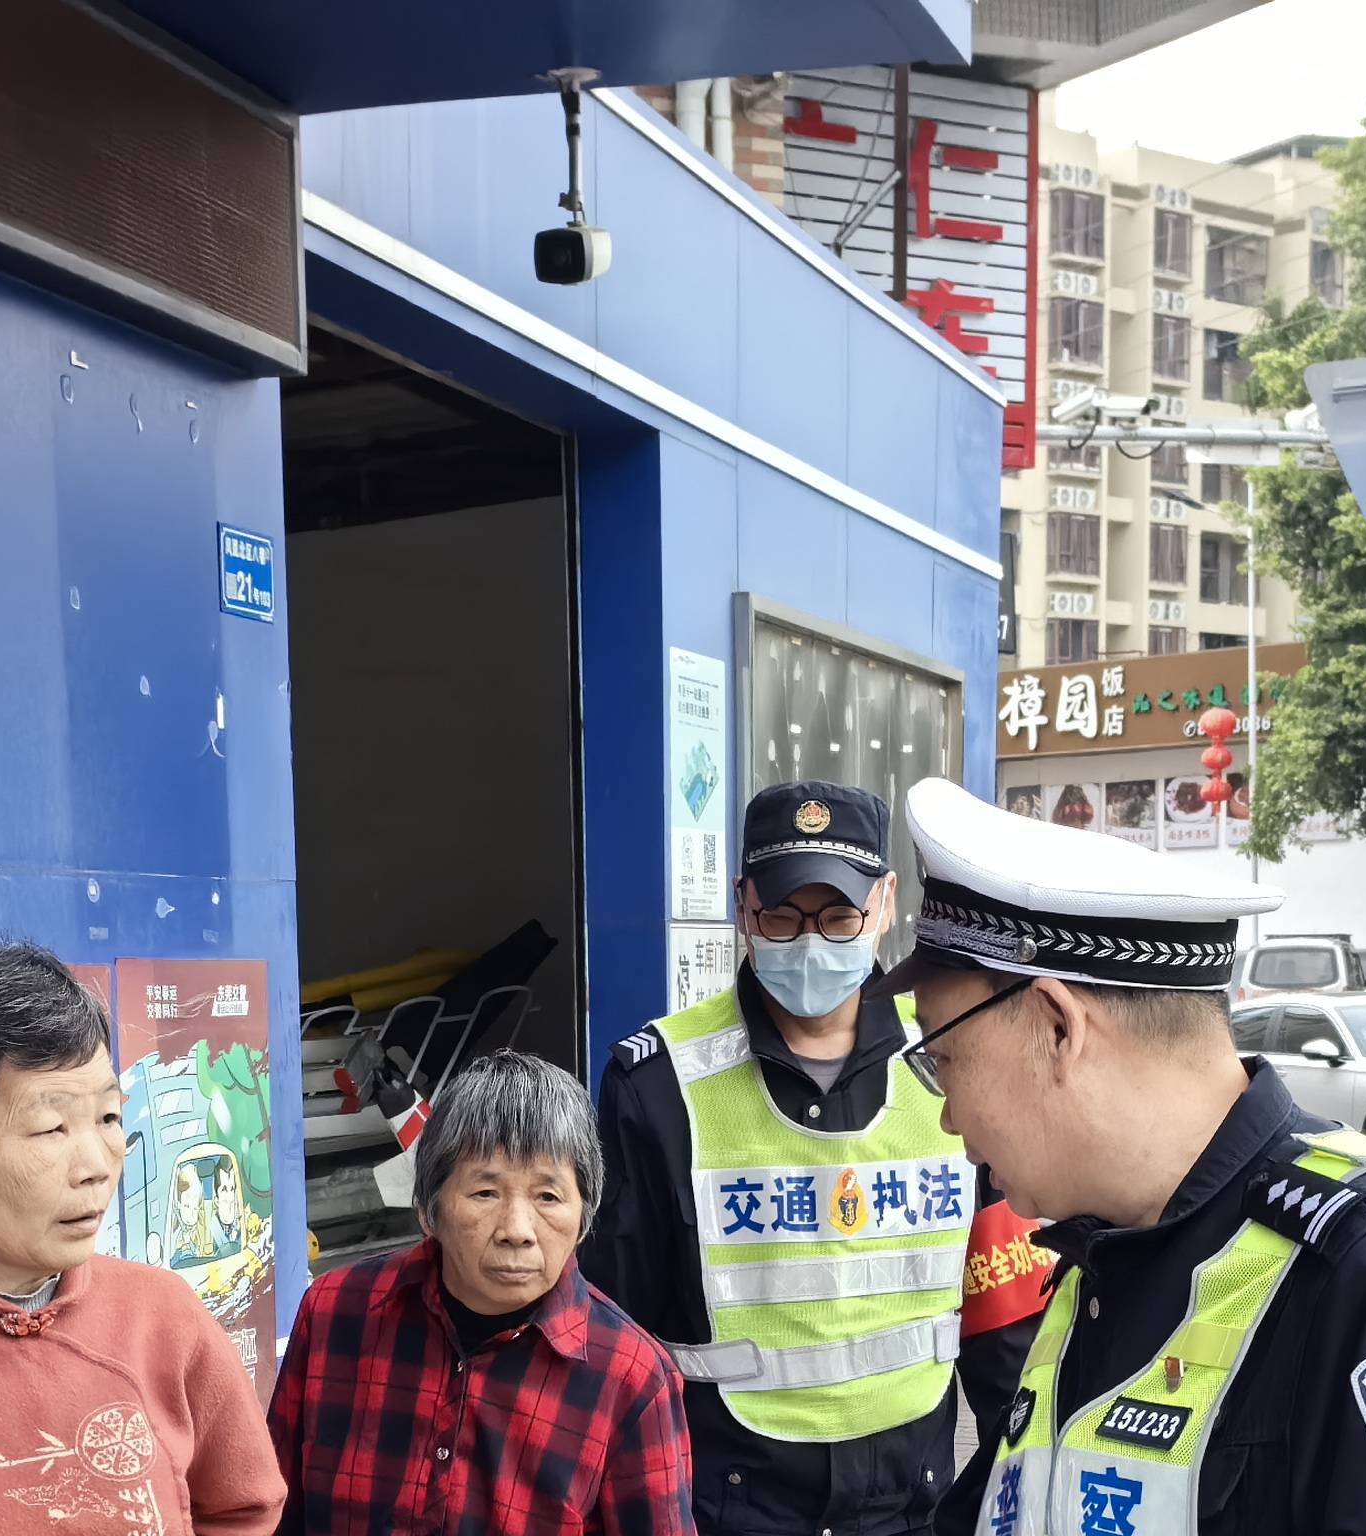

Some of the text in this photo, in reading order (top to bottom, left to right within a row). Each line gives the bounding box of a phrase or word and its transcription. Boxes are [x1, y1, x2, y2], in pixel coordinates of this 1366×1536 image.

[999, 674, 1098, 751] 樟园
[1102, 667, 1125, 737] 饭店
[720, 1164, 963, 1236] 交通 执法
[1104, 1403, 1181, 1440] 151233
